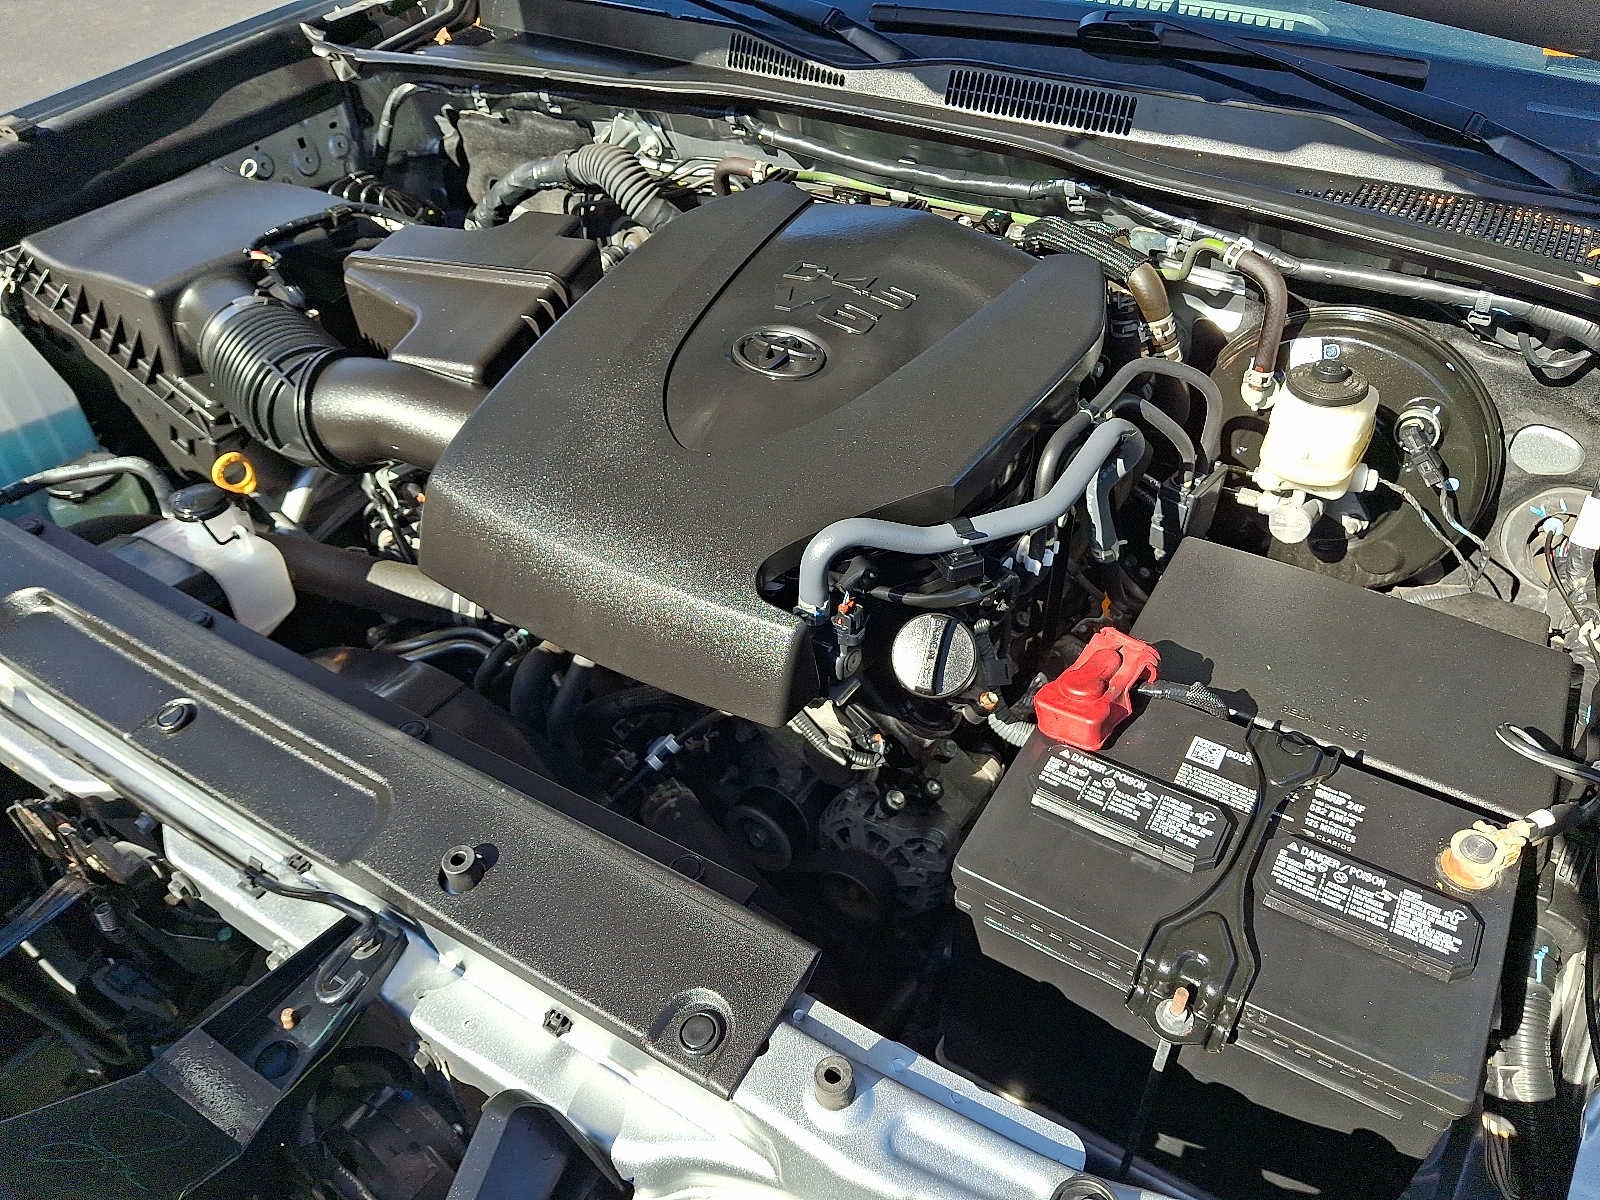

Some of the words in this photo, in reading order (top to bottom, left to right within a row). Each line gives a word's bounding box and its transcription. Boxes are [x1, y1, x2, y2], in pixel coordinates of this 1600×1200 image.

[774, 286, 882, 335] V6
[1071, 753, 1107, 775] DANGER
[1112, 772, 1148, 791] POISON
[1315, 788, 1346, 805] GROUP
[1346, 800, 1366, 814] 24F
[1328, 811, 1357, 828] AMPS
[1316, 835, 1352, 852] CLARIOS
[1319, 823, 1357, 844] MINUTES
[1300, 845, 1341, 869] DANGER
[1349, 864, 1388, 888] POISON
